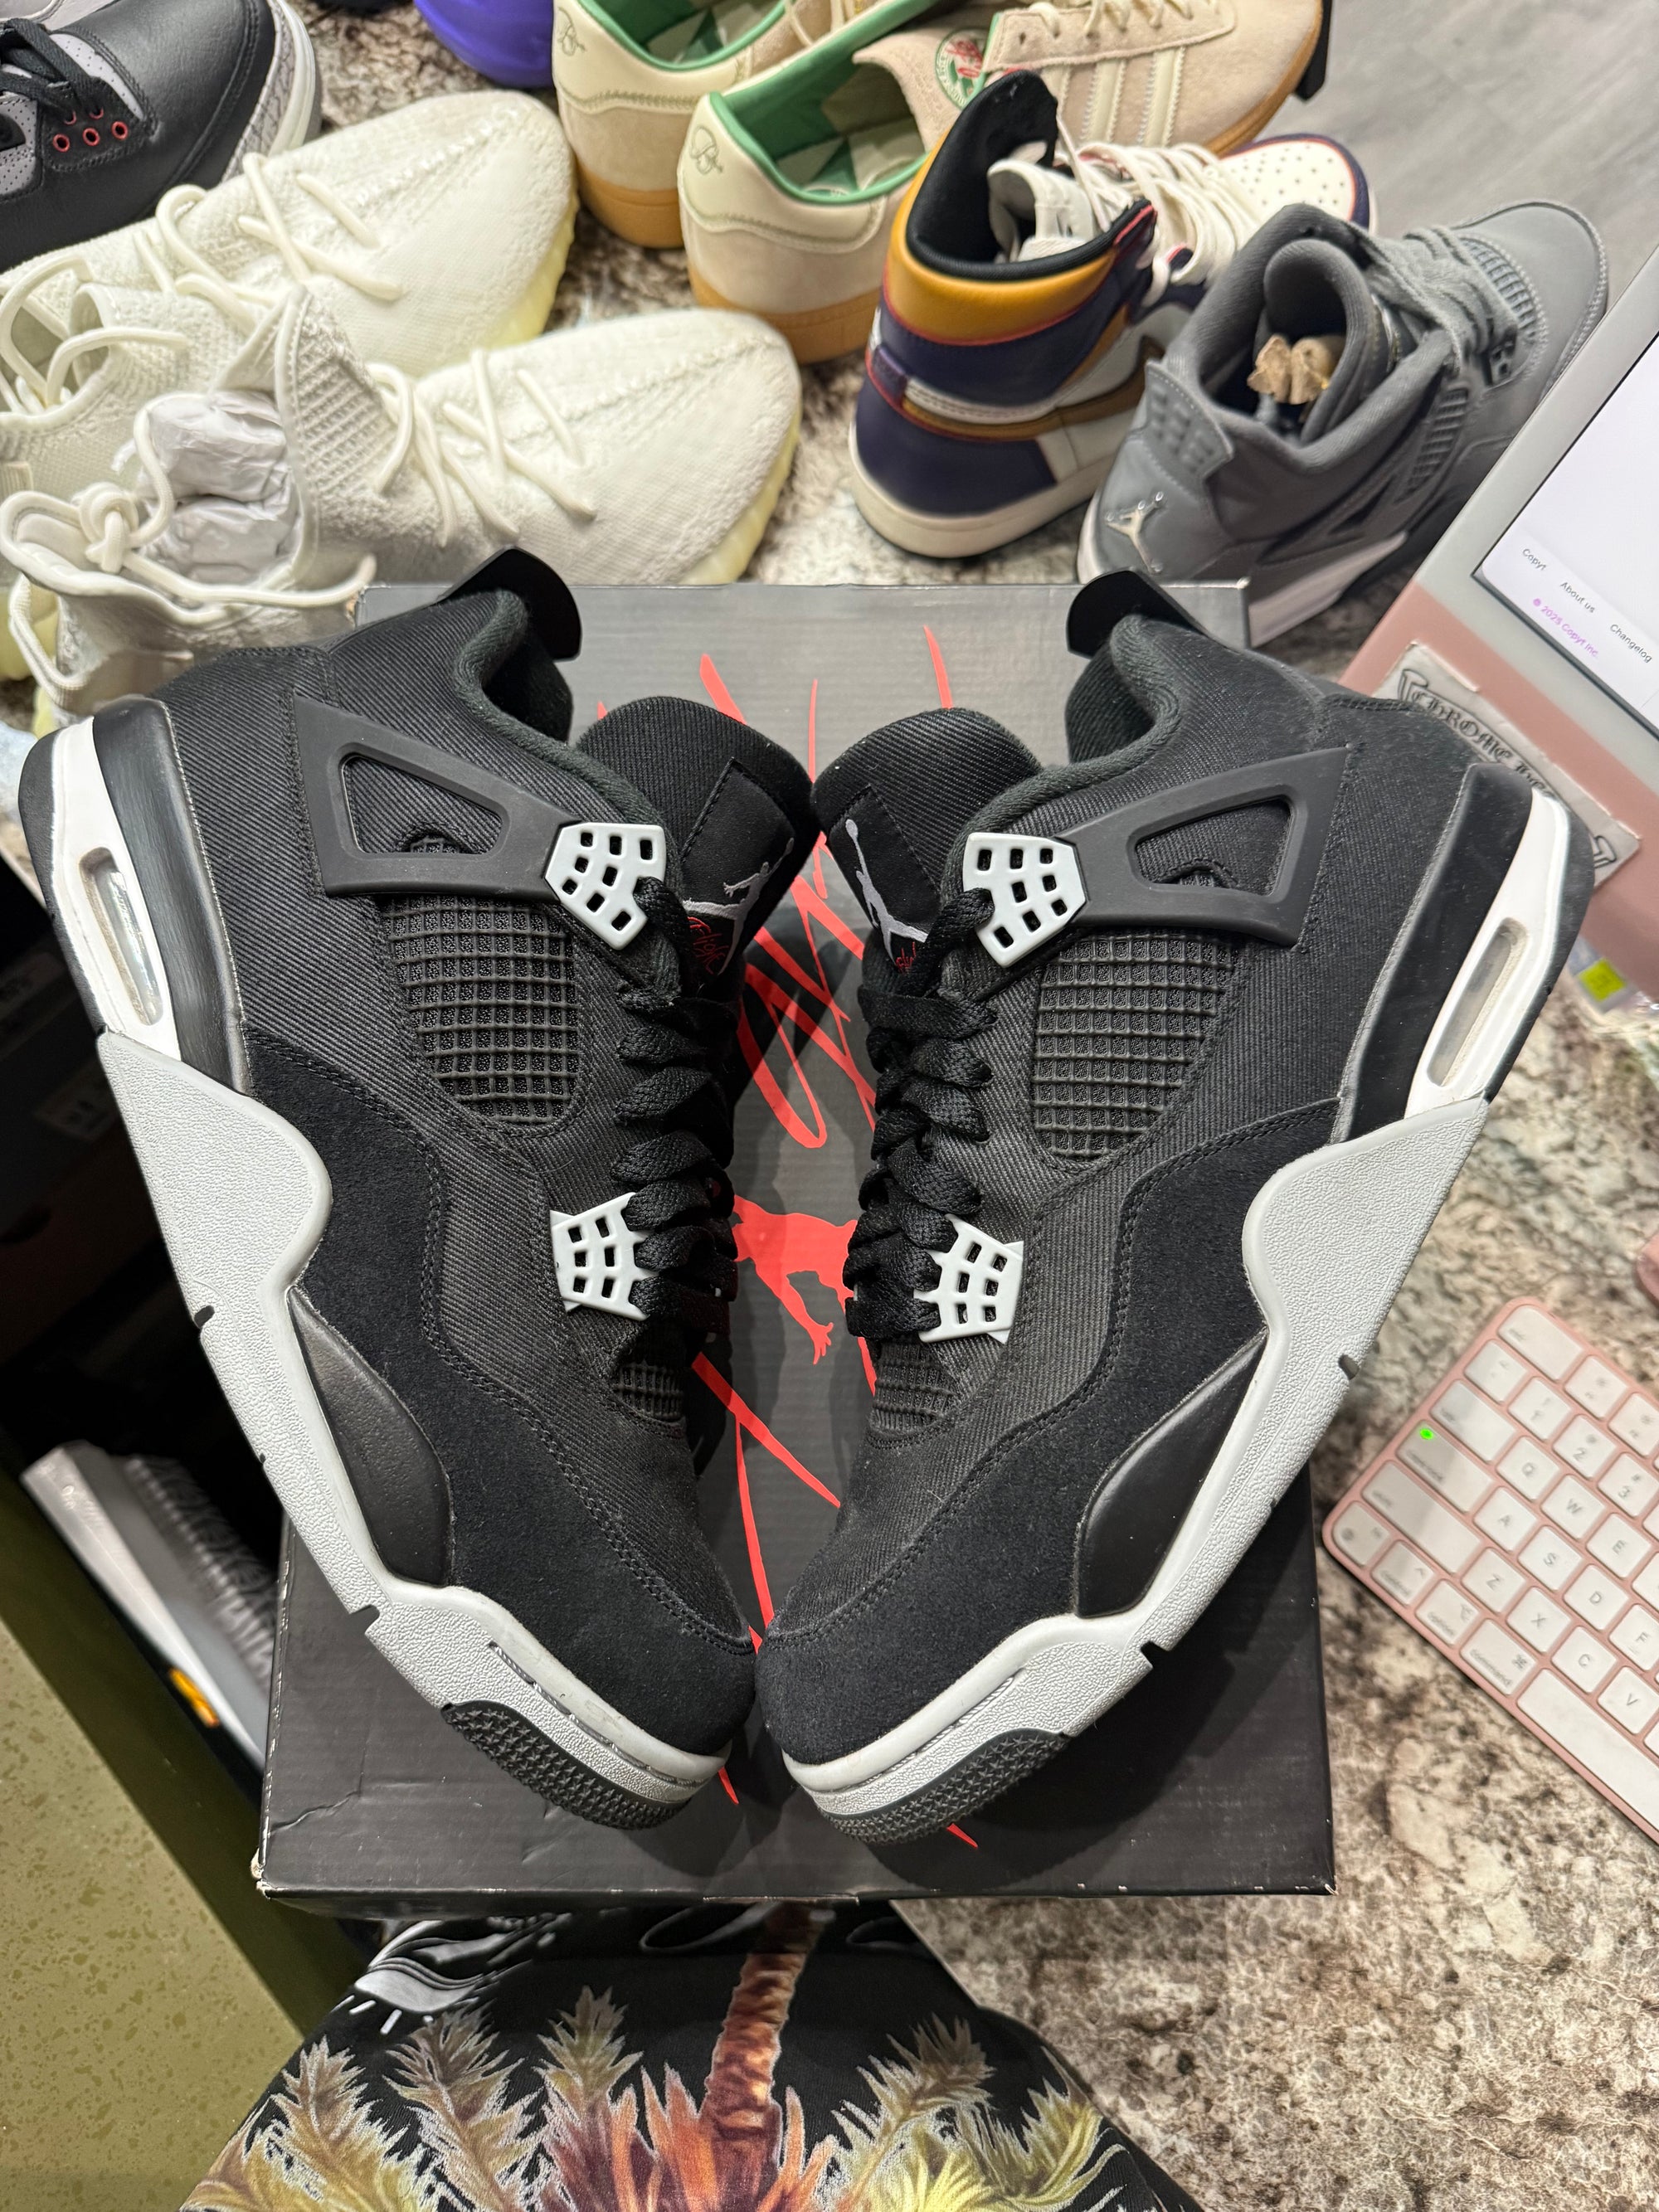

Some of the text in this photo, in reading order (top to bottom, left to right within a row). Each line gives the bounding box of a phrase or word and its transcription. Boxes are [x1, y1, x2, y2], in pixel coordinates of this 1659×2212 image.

[1522, 548, 1547, 571] Copyt
[1559, 581, 1595, 613] About us
[1541, 605, 1564, 625] 2025
[1561, 623, 1587, 645] Copyt
[1610, 624, 1652, 664] Changelog
[1573, 1447, 1587, 1461] 2
[1522, 1462, 1535, 1477] Q
[1618, 1485, 1631, 1500] 3
[1567, 1499, 1583, 1514] W
[1497, 1514, 1512, 1527] A
[1613, 1540, 1627, 1555] E
[1544, 1553, 1556, 1567] S
[1486, 1575, 1502, 1590] Z
[1589, 1591, 1602, 1606] D
[1531, 1613, 1546, 1628] X
[1636, 1631, 1649, 1643] F
[1578, 1653, 1591, 1668] C
[1626, 1694, 1639, 1707] V
